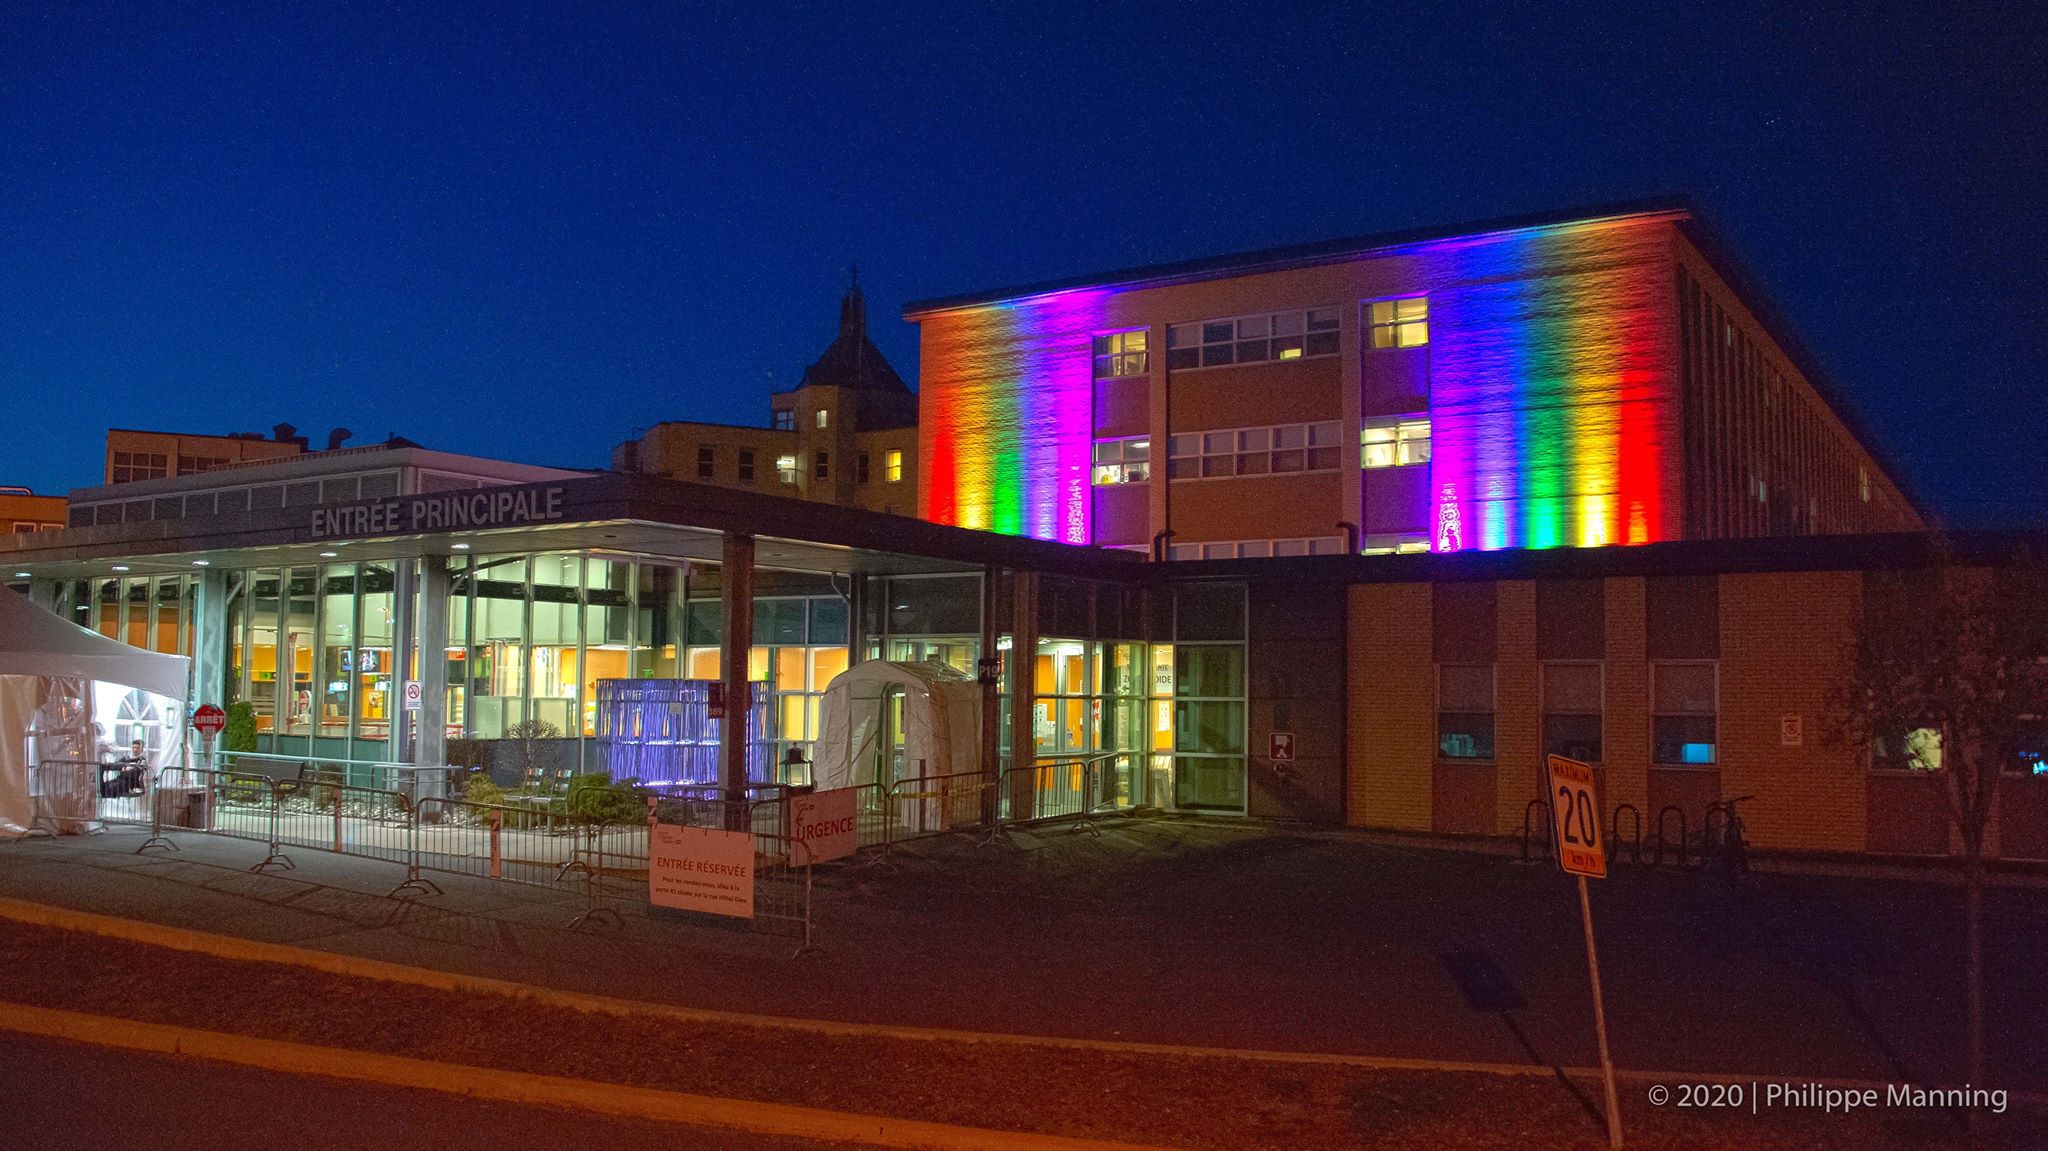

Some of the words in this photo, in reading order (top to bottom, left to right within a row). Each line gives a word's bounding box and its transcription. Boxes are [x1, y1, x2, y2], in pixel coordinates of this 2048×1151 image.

[311, 497, 399, 538] ENTRÉE
[412, 487, 563, 530] PRINCIPALE
[980, 664, 999, 678] P19
[194, 713, 224, 724] ARRÊT
[1553, 763, 1590, 782] MAXIMUM
[1559, 785, 1595, 848] 20
[796, 816, 854, 841] URGENCE
[657, 857, 694, 871] ENTRÉE
[696, 860, 746, 877] RÉSERVÉE
